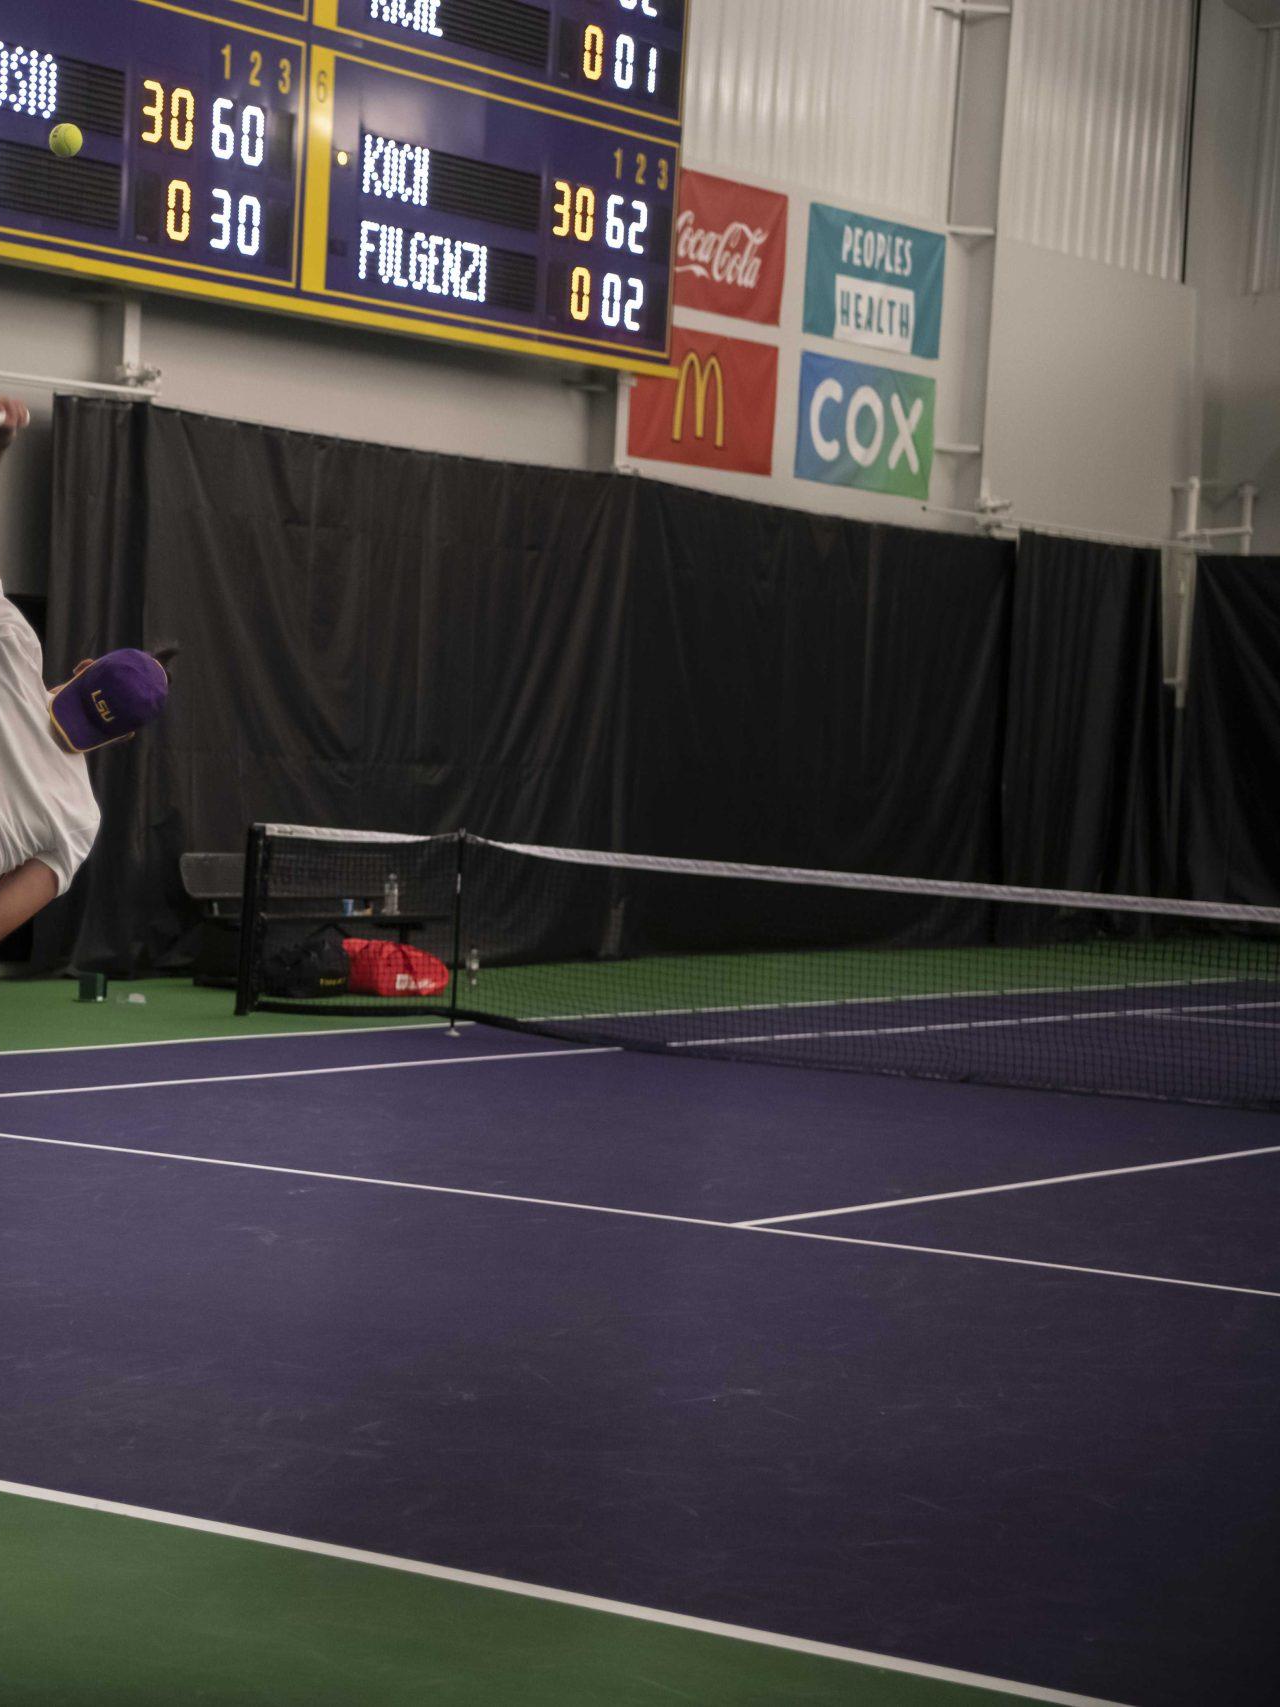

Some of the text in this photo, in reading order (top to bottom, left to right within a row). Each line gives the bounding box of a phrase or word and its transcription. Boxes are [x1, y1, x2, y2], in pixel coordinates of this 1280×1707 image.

[248, 50, 262, 87] 2
[278, 58, 291, 94] 3
[583, 24, 604, 80] 0
[141, 79, 195, 151] 30
[166, 179, 191, 242] 0
[362, 133, 430, 207] KOCH
[552, 181, 595, 242] 30
[358, 220, 488, 303] FULGENZI
[570, 266, 591, 321] 0
[841, 224, 913, 277] PEOPLES
[840, 289, 910, 340] HEALTH
[810, 377, 924, 476] COX
[91, 689, 115, 722] LSU
